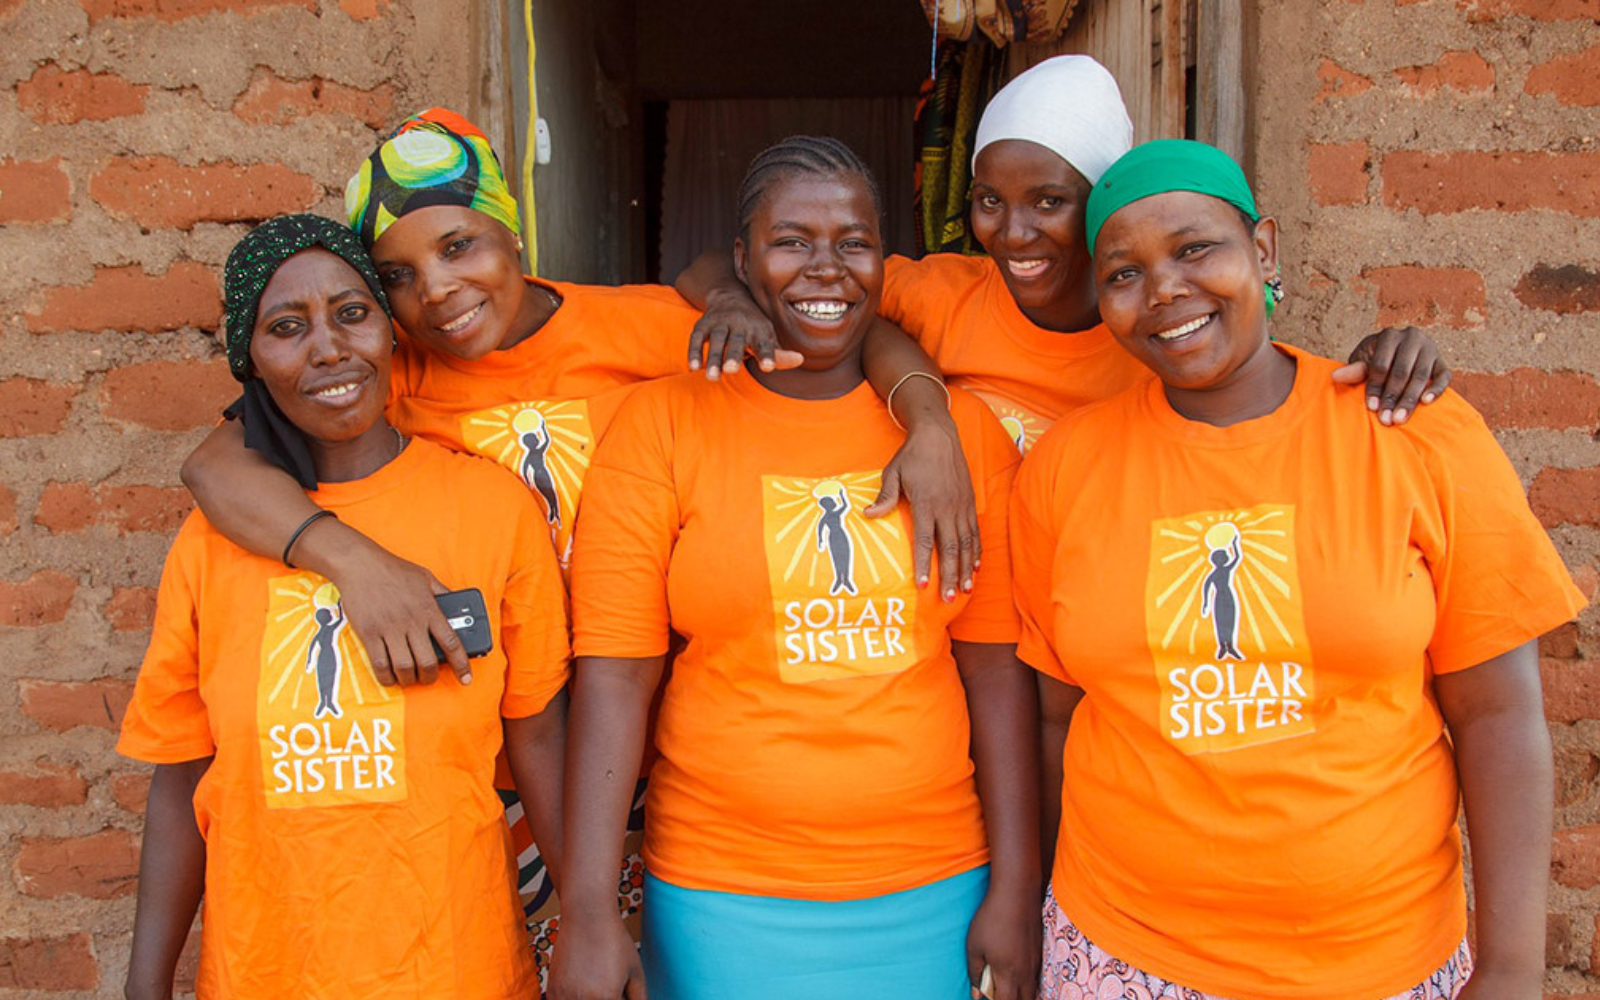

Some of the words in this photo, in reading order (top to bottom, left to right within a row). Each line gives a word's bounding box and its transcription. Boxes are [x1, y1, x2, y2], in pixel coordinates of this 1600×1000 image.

[784, 598, 906, 632] SOLAR
[784, 626, 906, 665] SISTER
[1168, 661, 1307, 703] SOLAR
[269, 718, 396, 759] SOLAR
[1169, 698, 1304, 739] SISTER
[272, 754, 396, 793] SISTER
